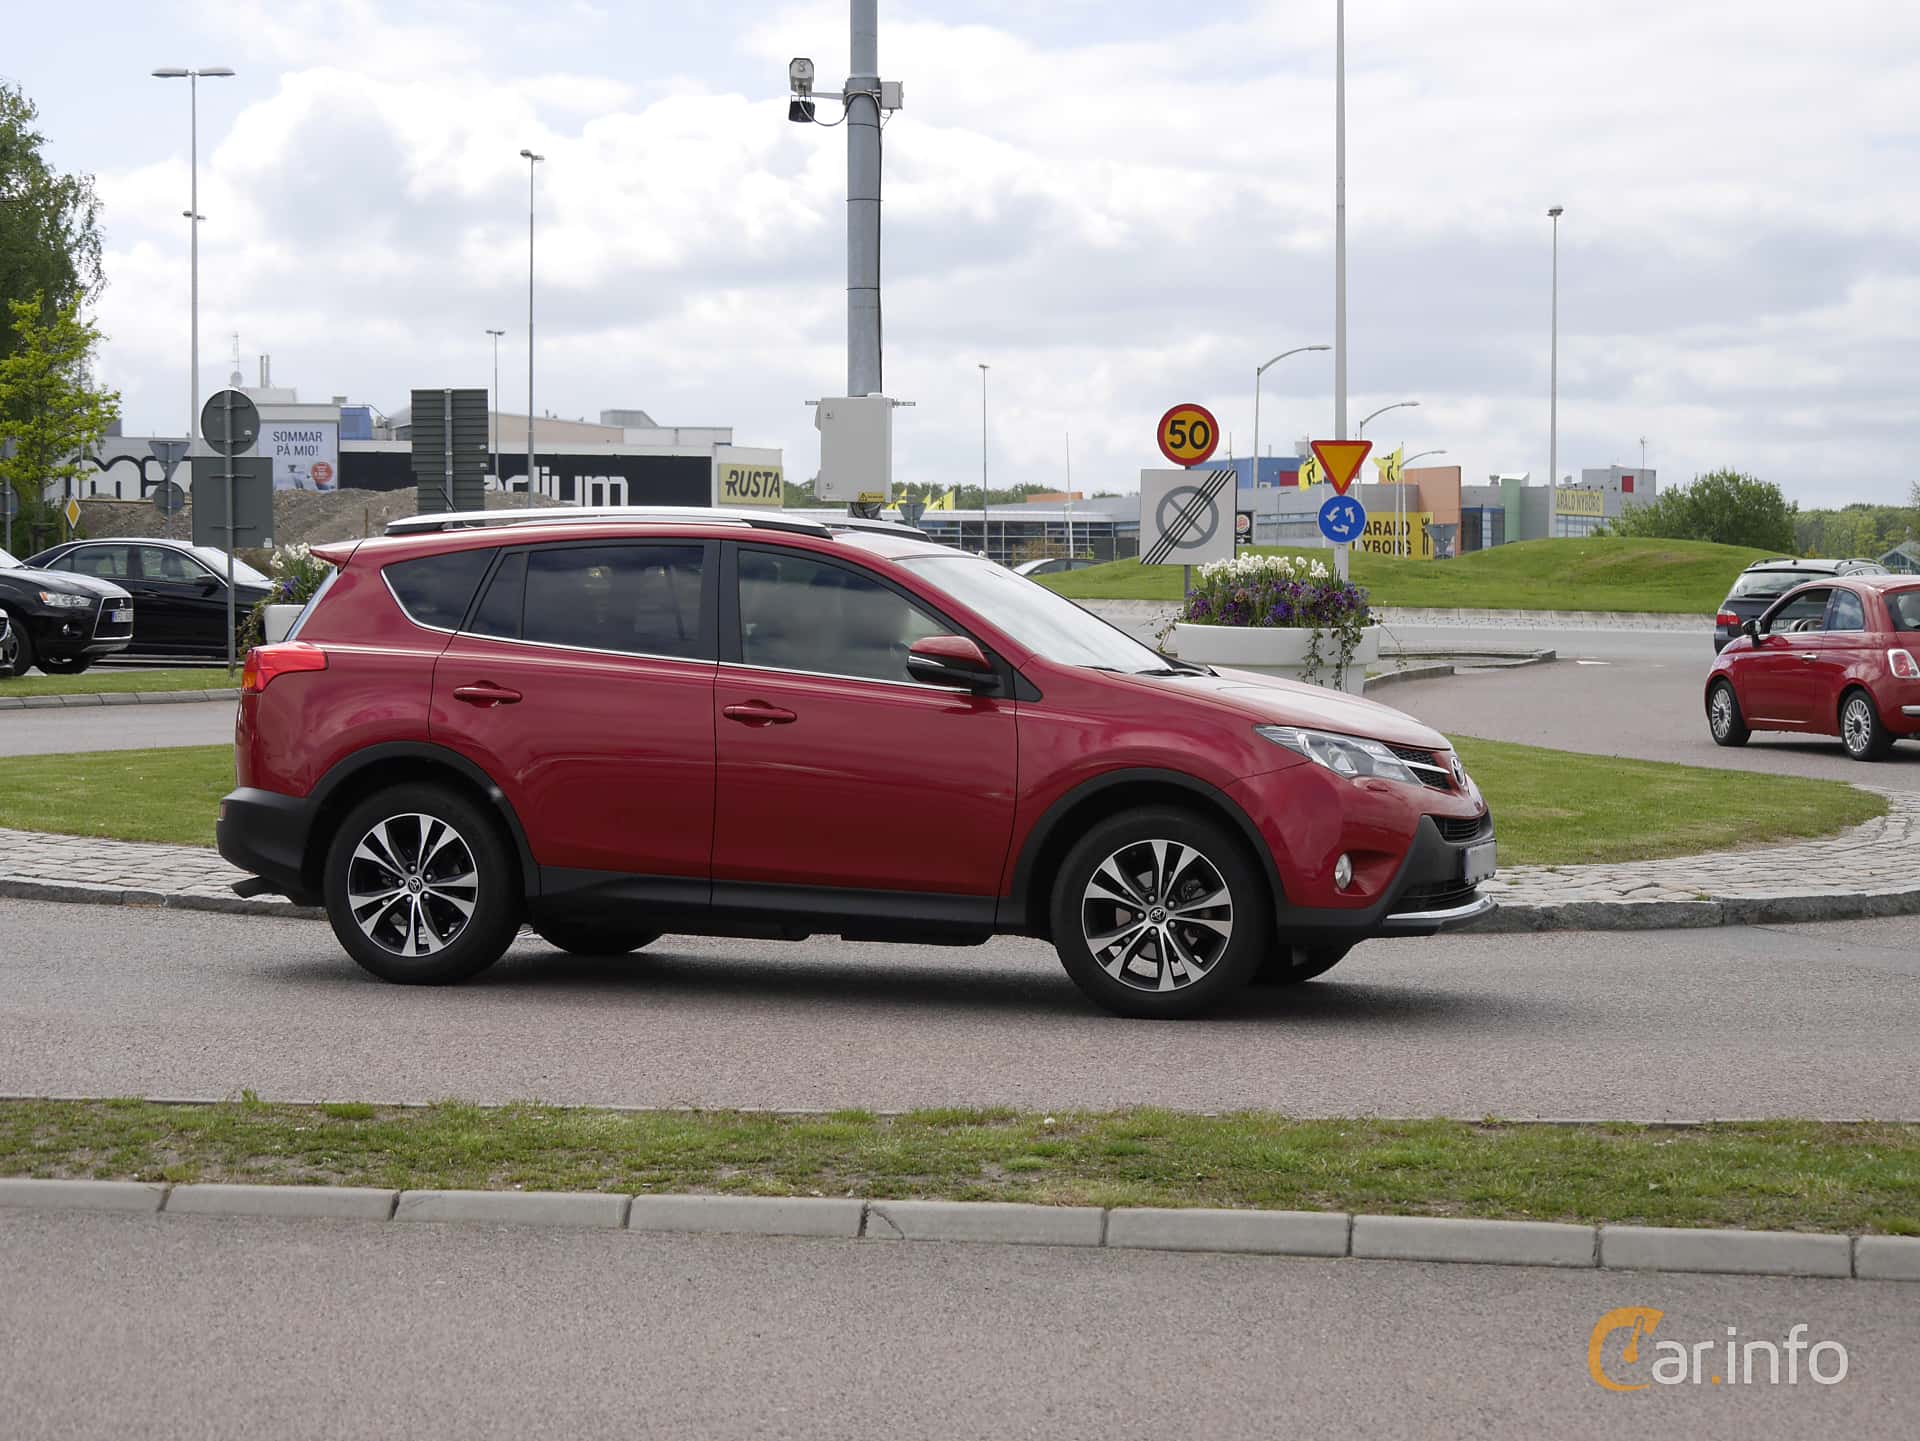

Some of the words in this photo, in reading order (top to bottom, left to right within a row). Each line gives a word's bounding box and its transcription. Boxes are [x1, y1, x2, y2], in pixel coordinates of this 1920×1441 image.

[272, 431, 322, 442] SOMMAR
[1169, 419, 1210, 450] 50
[276, 443, 291, 456] PÅ
[294, 445, 319, 456] MIO!
[725, 470, 780, 498] RUSTA
[1363, 521, 1411, 536] ARALD
